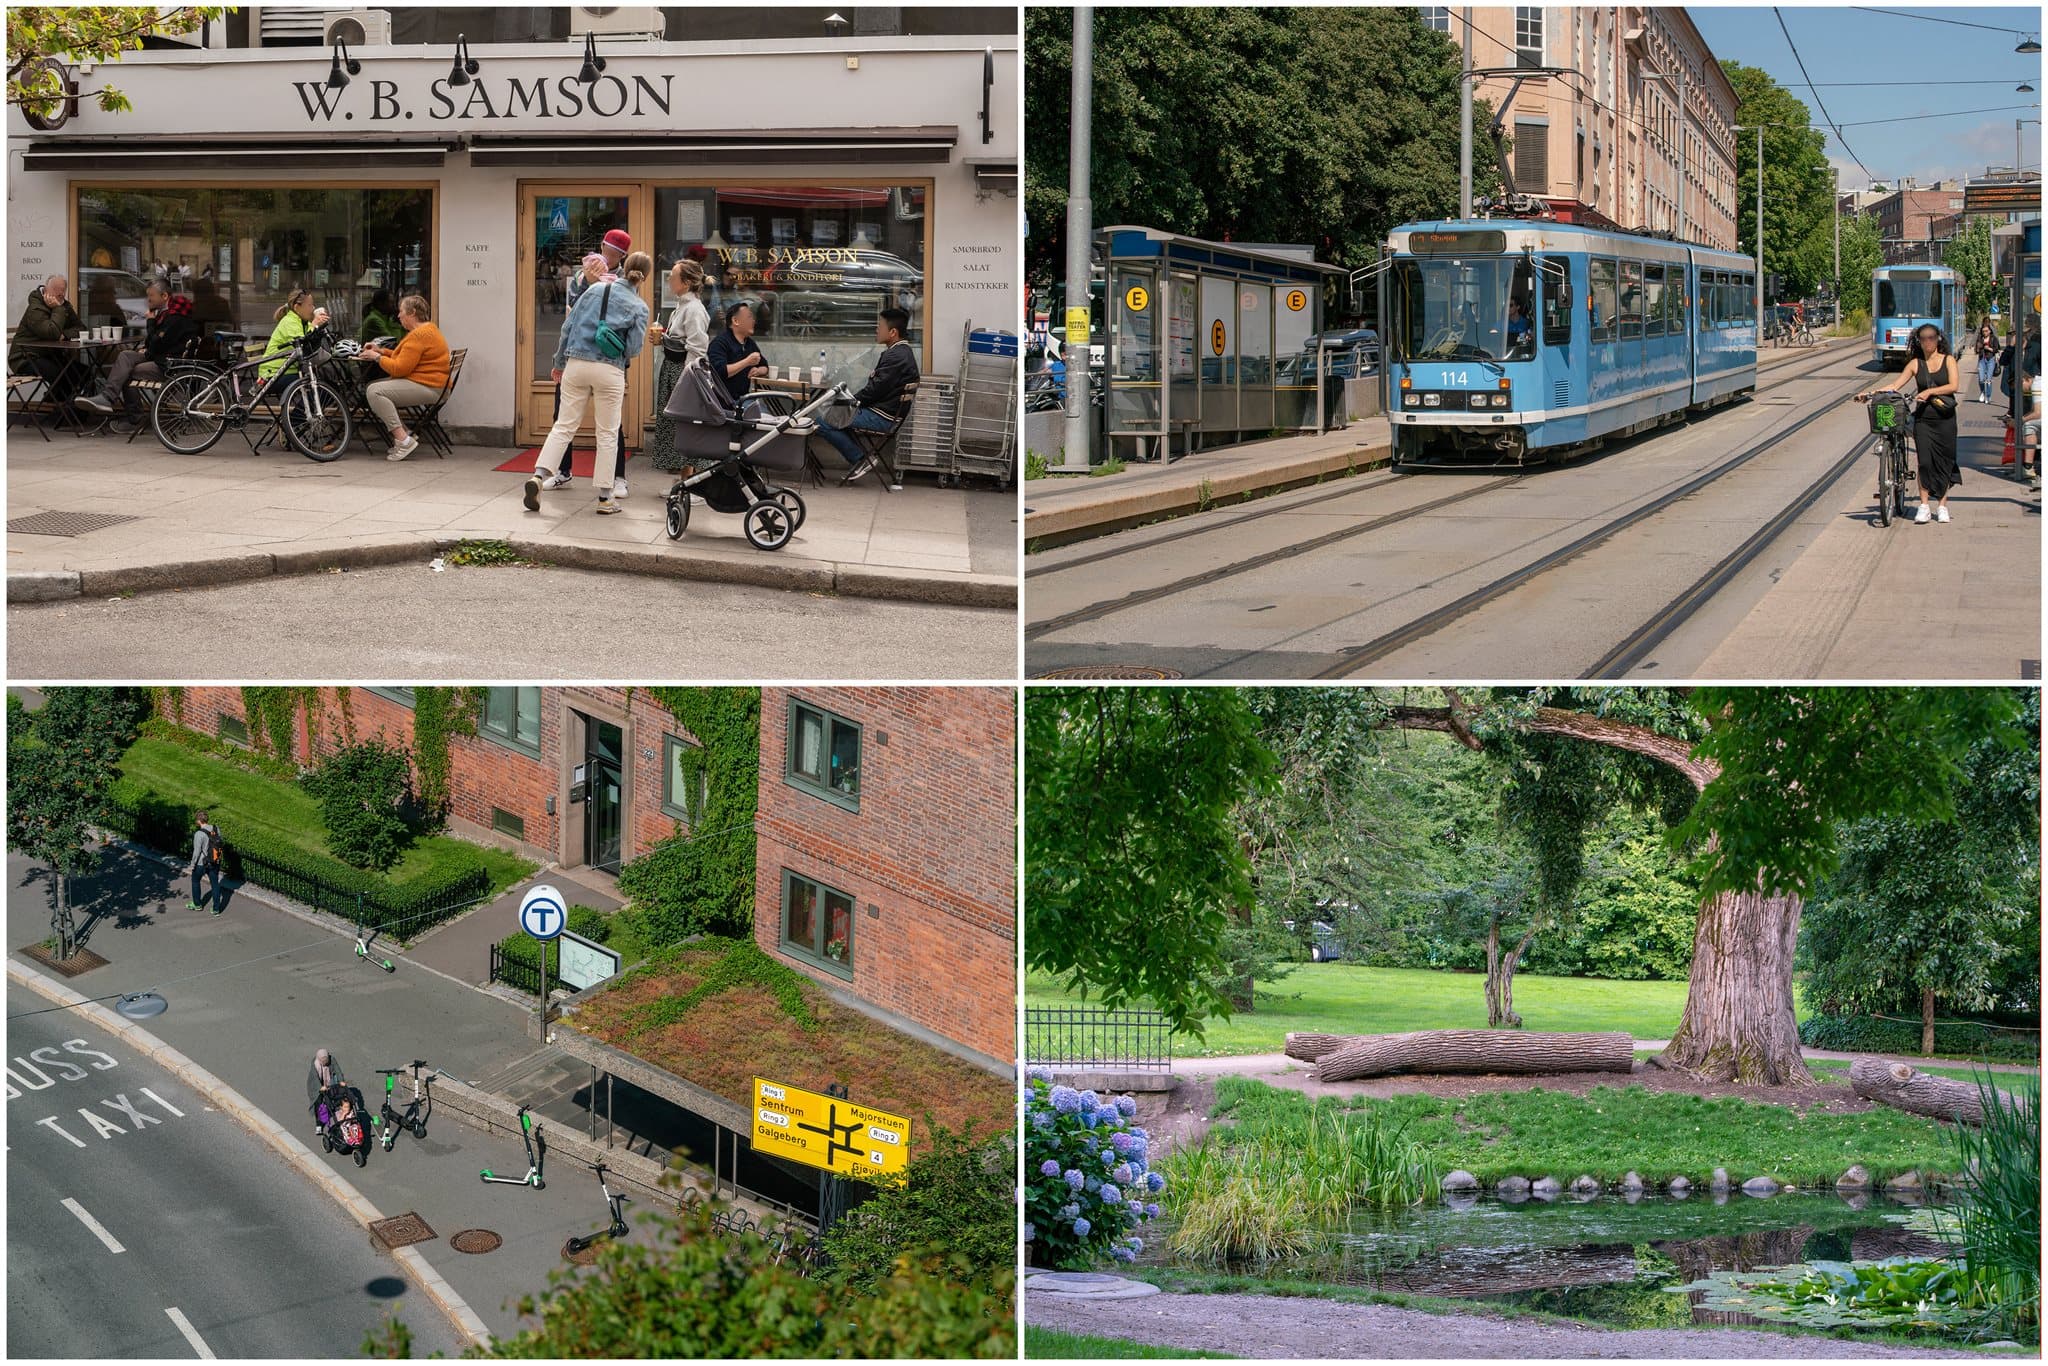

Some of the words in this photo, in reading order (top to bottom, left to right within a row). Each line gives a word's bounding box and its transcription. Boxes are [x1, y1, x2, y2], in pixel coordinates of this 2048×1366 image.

[292, 81, 354, 122] W.
[369, 80, 413, 120] B.
[428, 74, 676, 121] SAMSON
[716, 247, 740, 264] W.
[745, 248, 762, 264] B.
[768, 247, 858, 264] SAMSON
[952, 245, 1002, 254] SMØRBRØD
[963, 264, 991, 272] SALAT
[737, 272, 775, 282] BAKERI
[787, 272, 843, 282] KONDITORI
[944, 282, 1009, 290] RUNDSTYKKER
[1132, 291, 1142, 306] E
[1292, 294, 1301, 307] E
[1215, 327, 1222, 348] E
[1441, 371, 1468, 386] 114
[531, 908, 555, 933] T
[7, 1038, 119, 1100] USS
[763, 1086, 779, 1097] Ring
[760, 1097, 804, 1117] Sentrum
[35, 1087, 186, 1148] TAXI
[763, 1112, 780, 1124] Ring
[780, 1116, 785, 1124] 2
[850, 1107, 905, 1130] Majorstuen
[758, 1125, 807, 1148] Galgeberg
[873, 1130, 890, 1142] Ring
[890, 1134, 896, 1142] 2
[873, 1153, 880, 1162] 4
